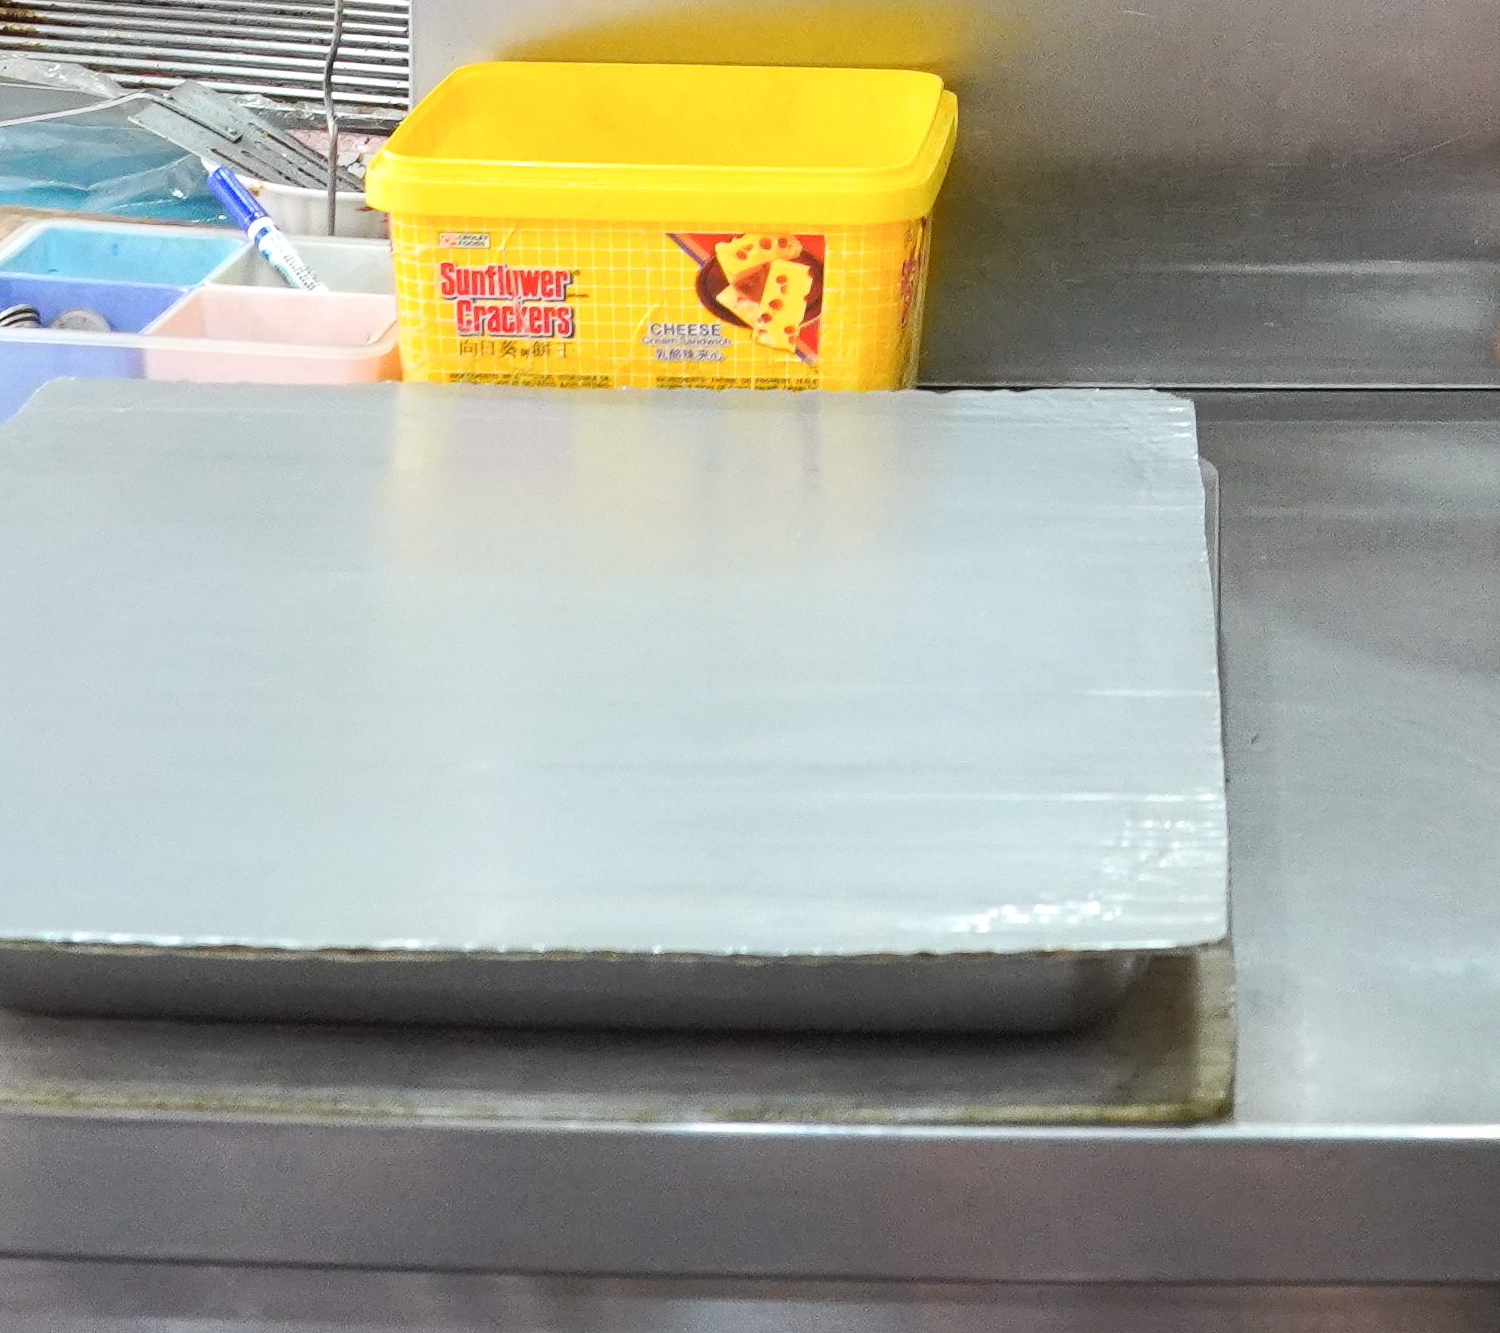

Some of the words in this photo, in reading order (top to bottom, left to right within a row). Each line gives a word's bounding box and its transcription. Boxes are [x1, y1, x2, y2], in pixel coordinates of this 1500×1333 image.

[440, 262, 573, 301] Sunflower
[457, 298, 576, 338] Crackers
[650, 323, 722, 337] CHEESE
